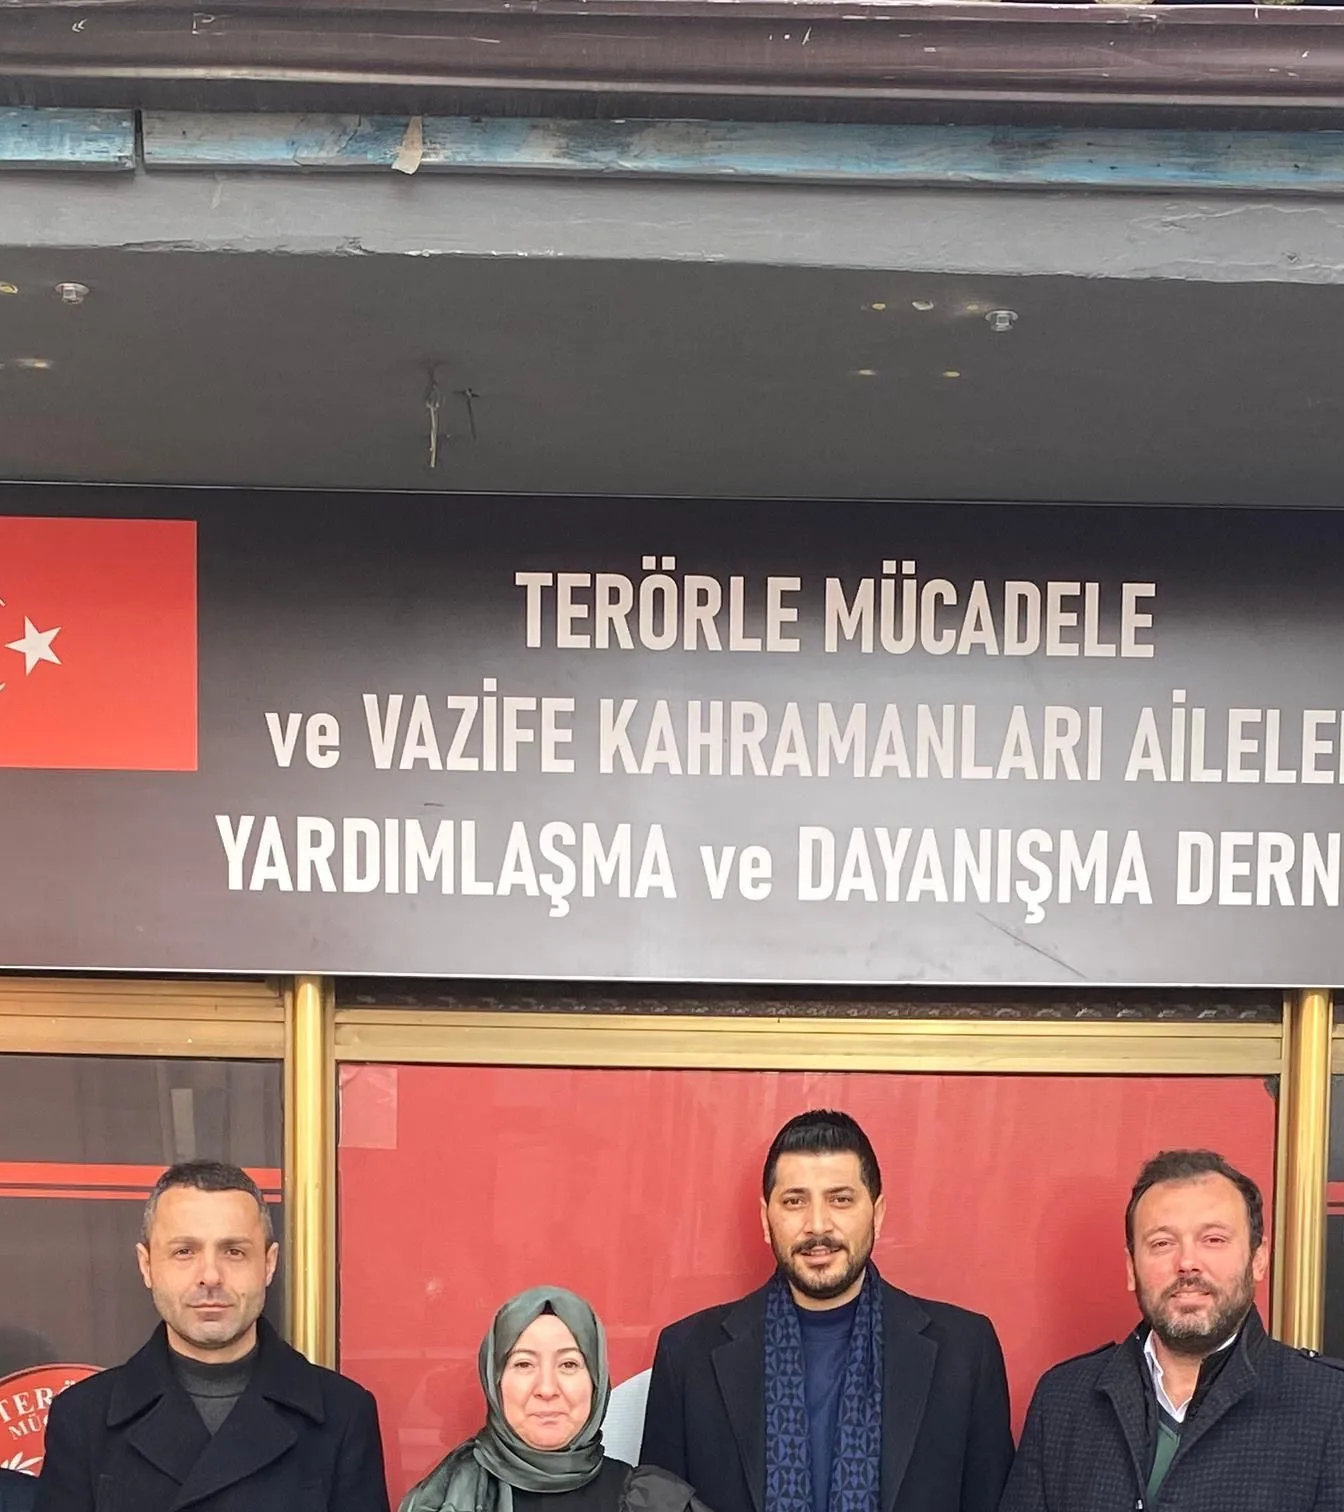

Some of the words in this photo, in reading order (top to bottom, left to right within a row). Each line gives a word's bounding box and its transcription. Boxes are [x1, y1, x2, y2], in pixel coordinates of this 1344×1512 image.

[515, 555, 801, 652] TERÖRLE
[825, 559, 1156, 658] MÜCADELE
[264, 712, 340, 769] ve
[362, 677, 575, 773] VAZİFE
[599, 698, 1103, 782] KAHRAMANLARI
[215, 814, 677, 917] YARDIMLAŞMA
[700, 846, 772, 900] ve
[798, 826, 1153, 924] DAYANIŞMA
